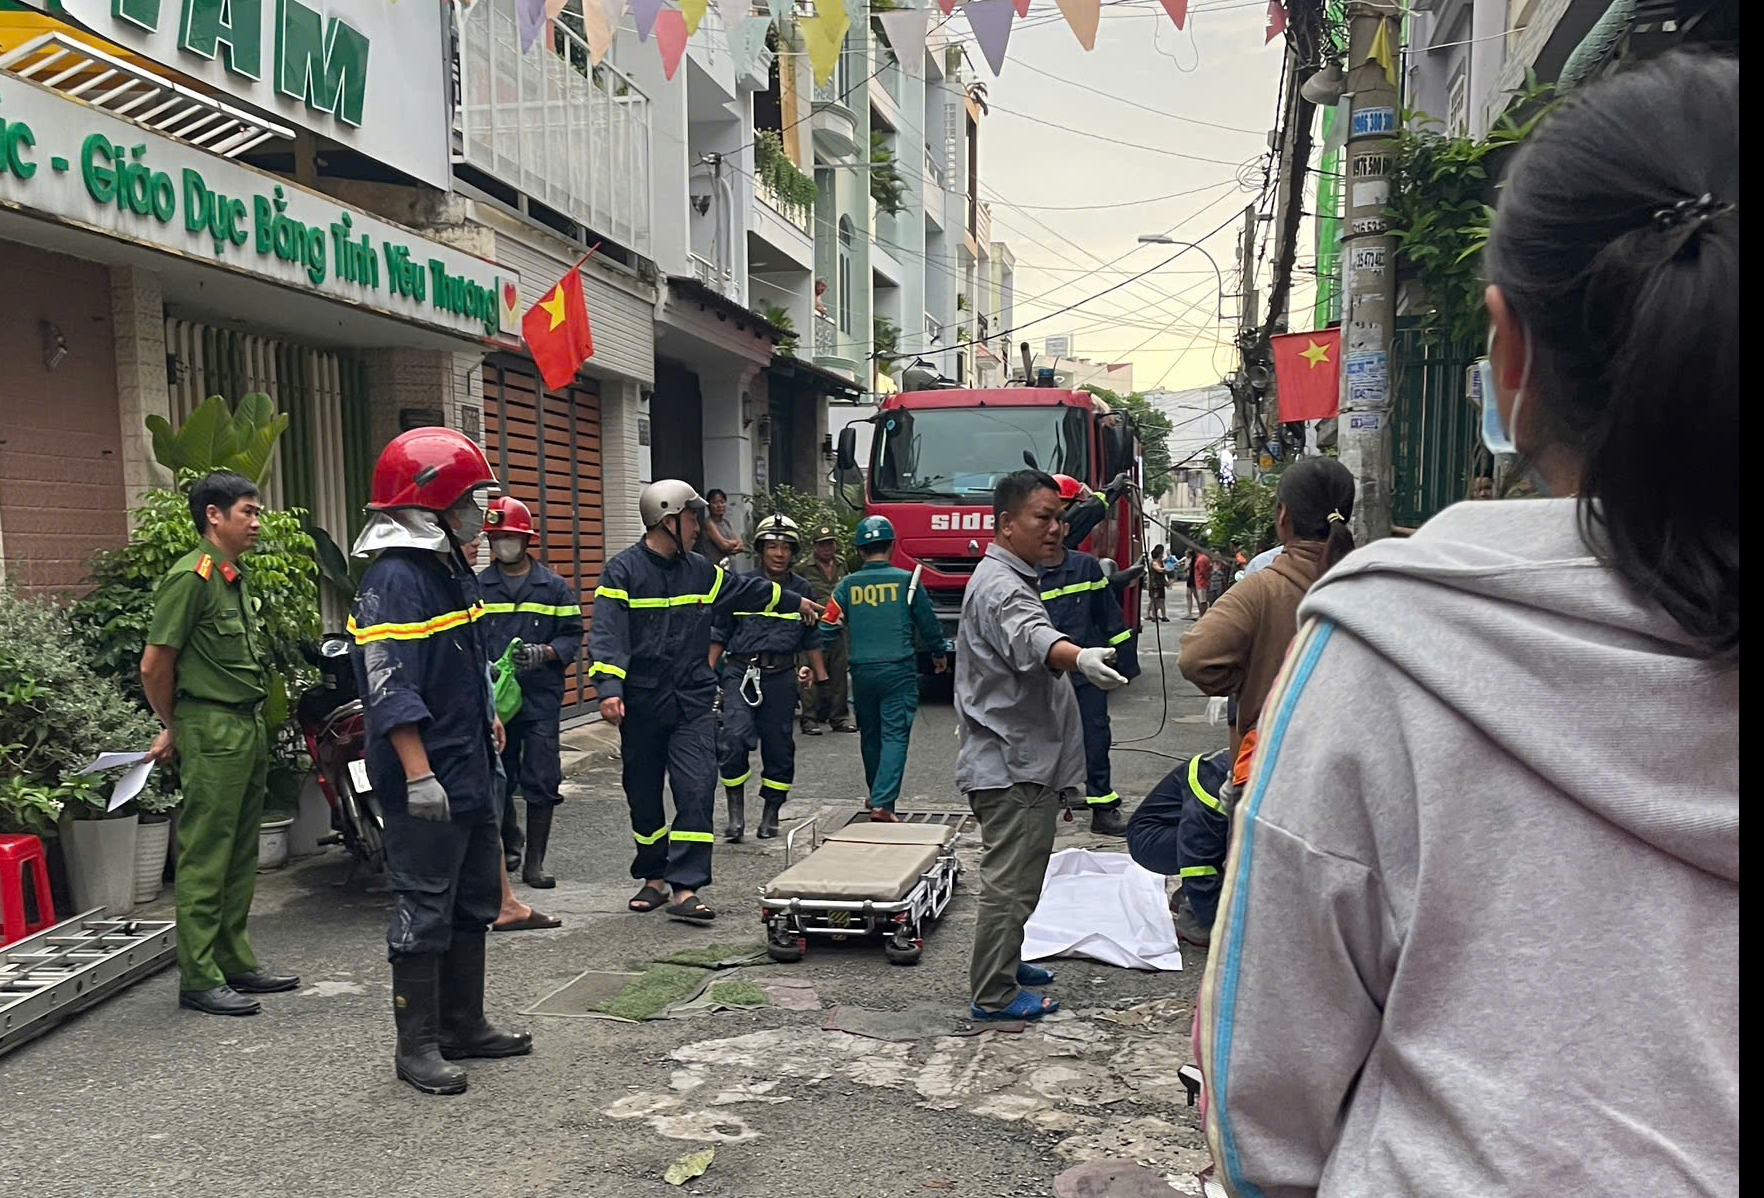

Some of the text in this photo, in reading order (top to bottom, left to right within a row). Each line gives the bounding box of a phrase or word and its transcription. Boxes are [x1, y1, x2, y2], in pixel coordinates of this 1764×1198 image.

[81, 133, 176, 223] Giáo
[182, 167, 249, 255] Dục
[253, 183, 327, 285] Bằng
[330, 211, 380, 289] Tình
[383, 241, 426, 302] Yêu
[427, 257, 498, 337] Thương
[850, 582, 900, 607] DQTT
